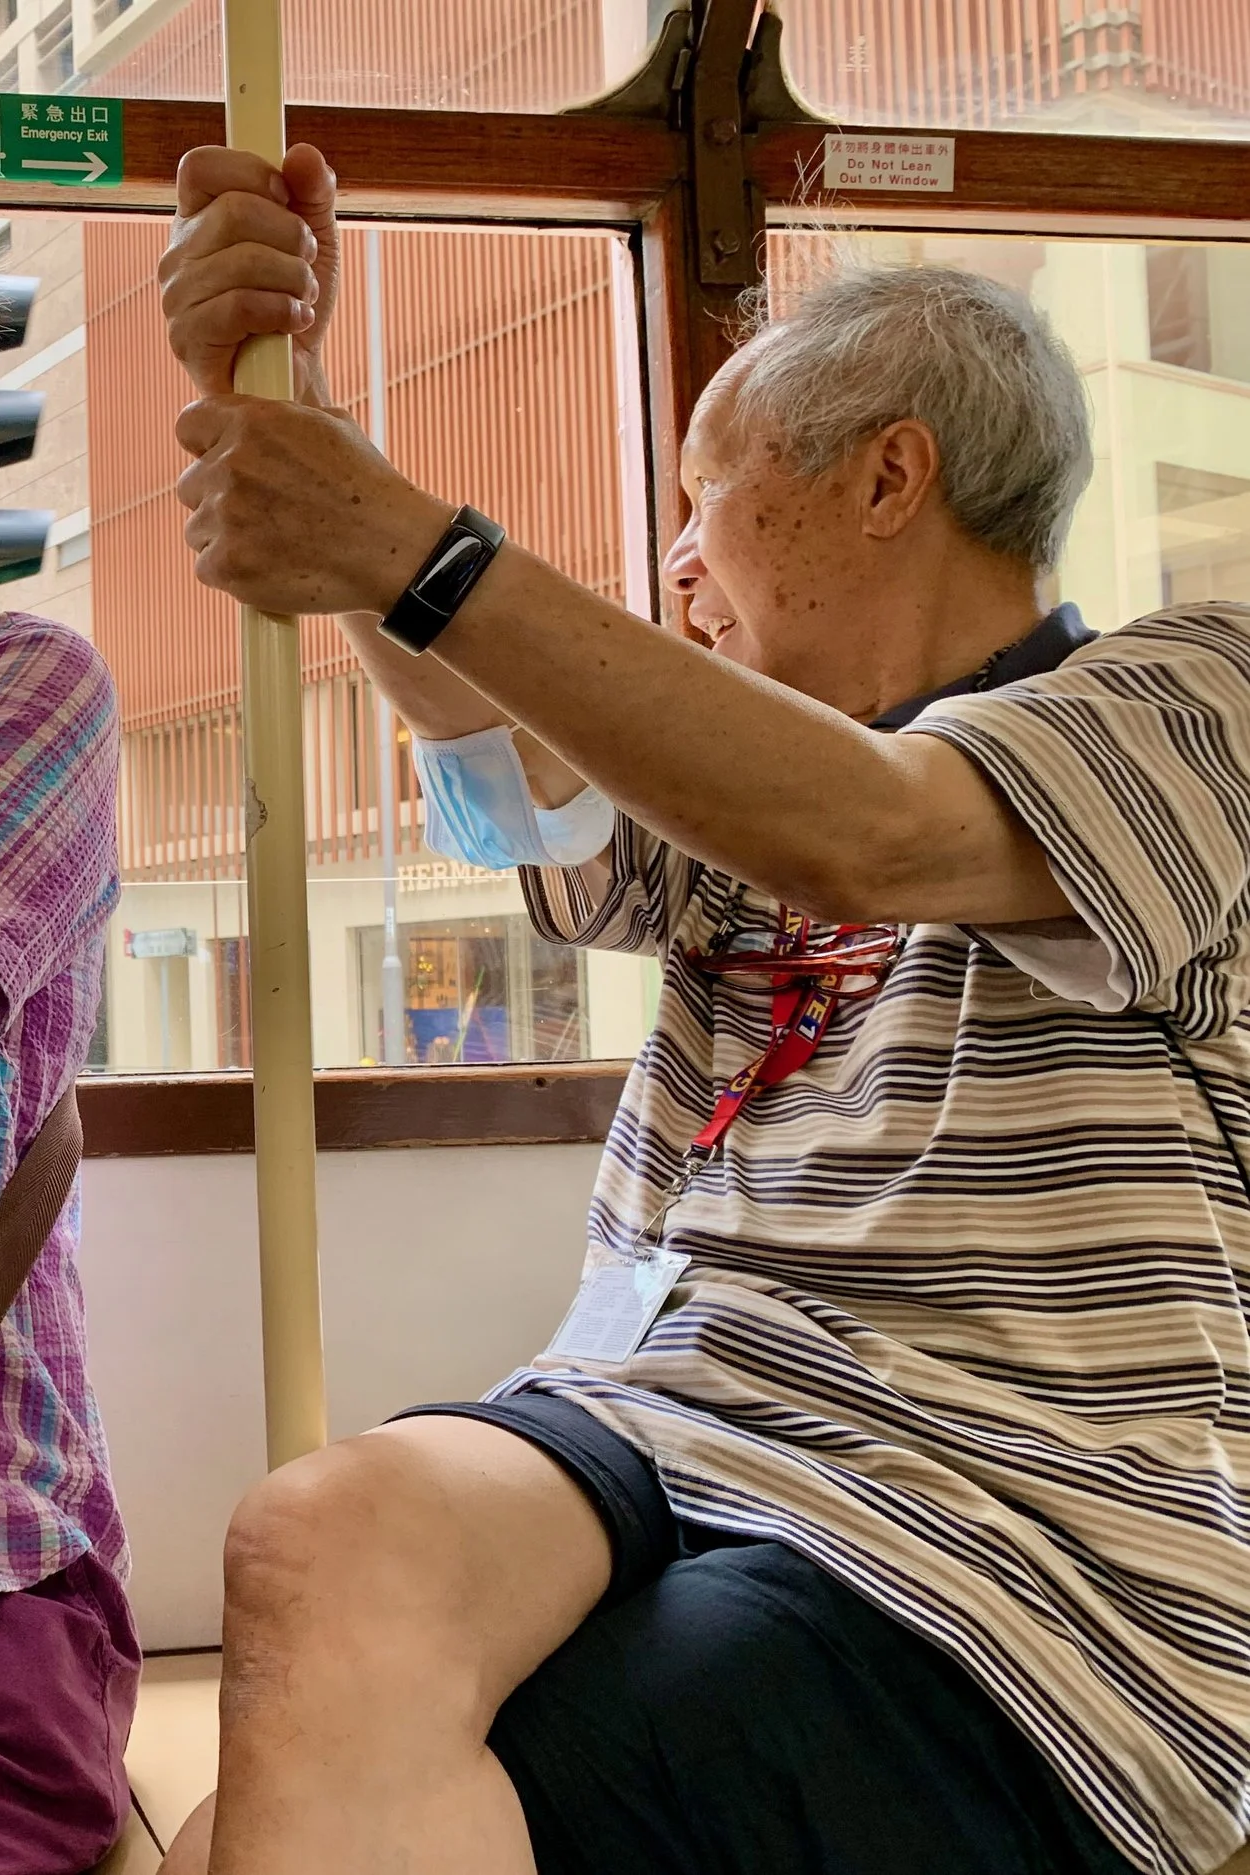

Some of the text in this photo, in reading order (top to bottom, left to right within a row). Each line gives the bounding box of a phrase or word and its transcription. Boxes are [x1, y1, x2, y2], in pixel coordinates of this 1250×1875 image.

[21, 103, 109, 123] 緊急出口
[21, 126, 109, 142] Emergency Exit
[848, 158, 932, 171] Do Not Lean
[840, 173, 939, 186] Out of Window
